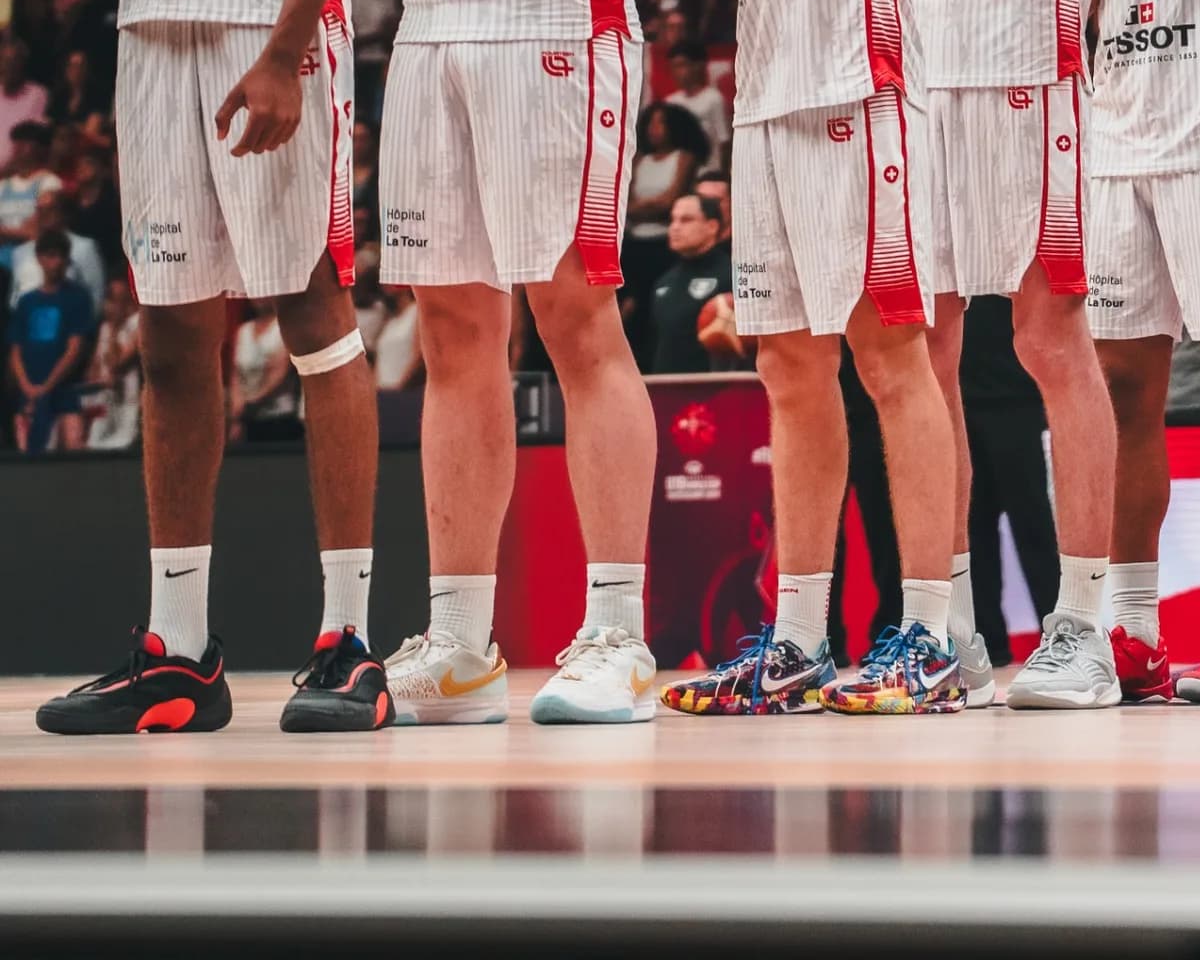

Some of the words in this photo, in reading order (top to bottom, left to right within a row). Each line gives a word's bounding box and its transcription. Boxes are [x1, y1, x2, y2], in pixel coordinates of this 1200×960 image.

[386, 235, 399, 247] La
[400, 235, 429, 248] Tour
[738, 288, 748, 298] La
[749, 288, 772, 299] Tour
[1087, 297, 1099, 307] La
[1100, 298, 1125, 308] Tour
